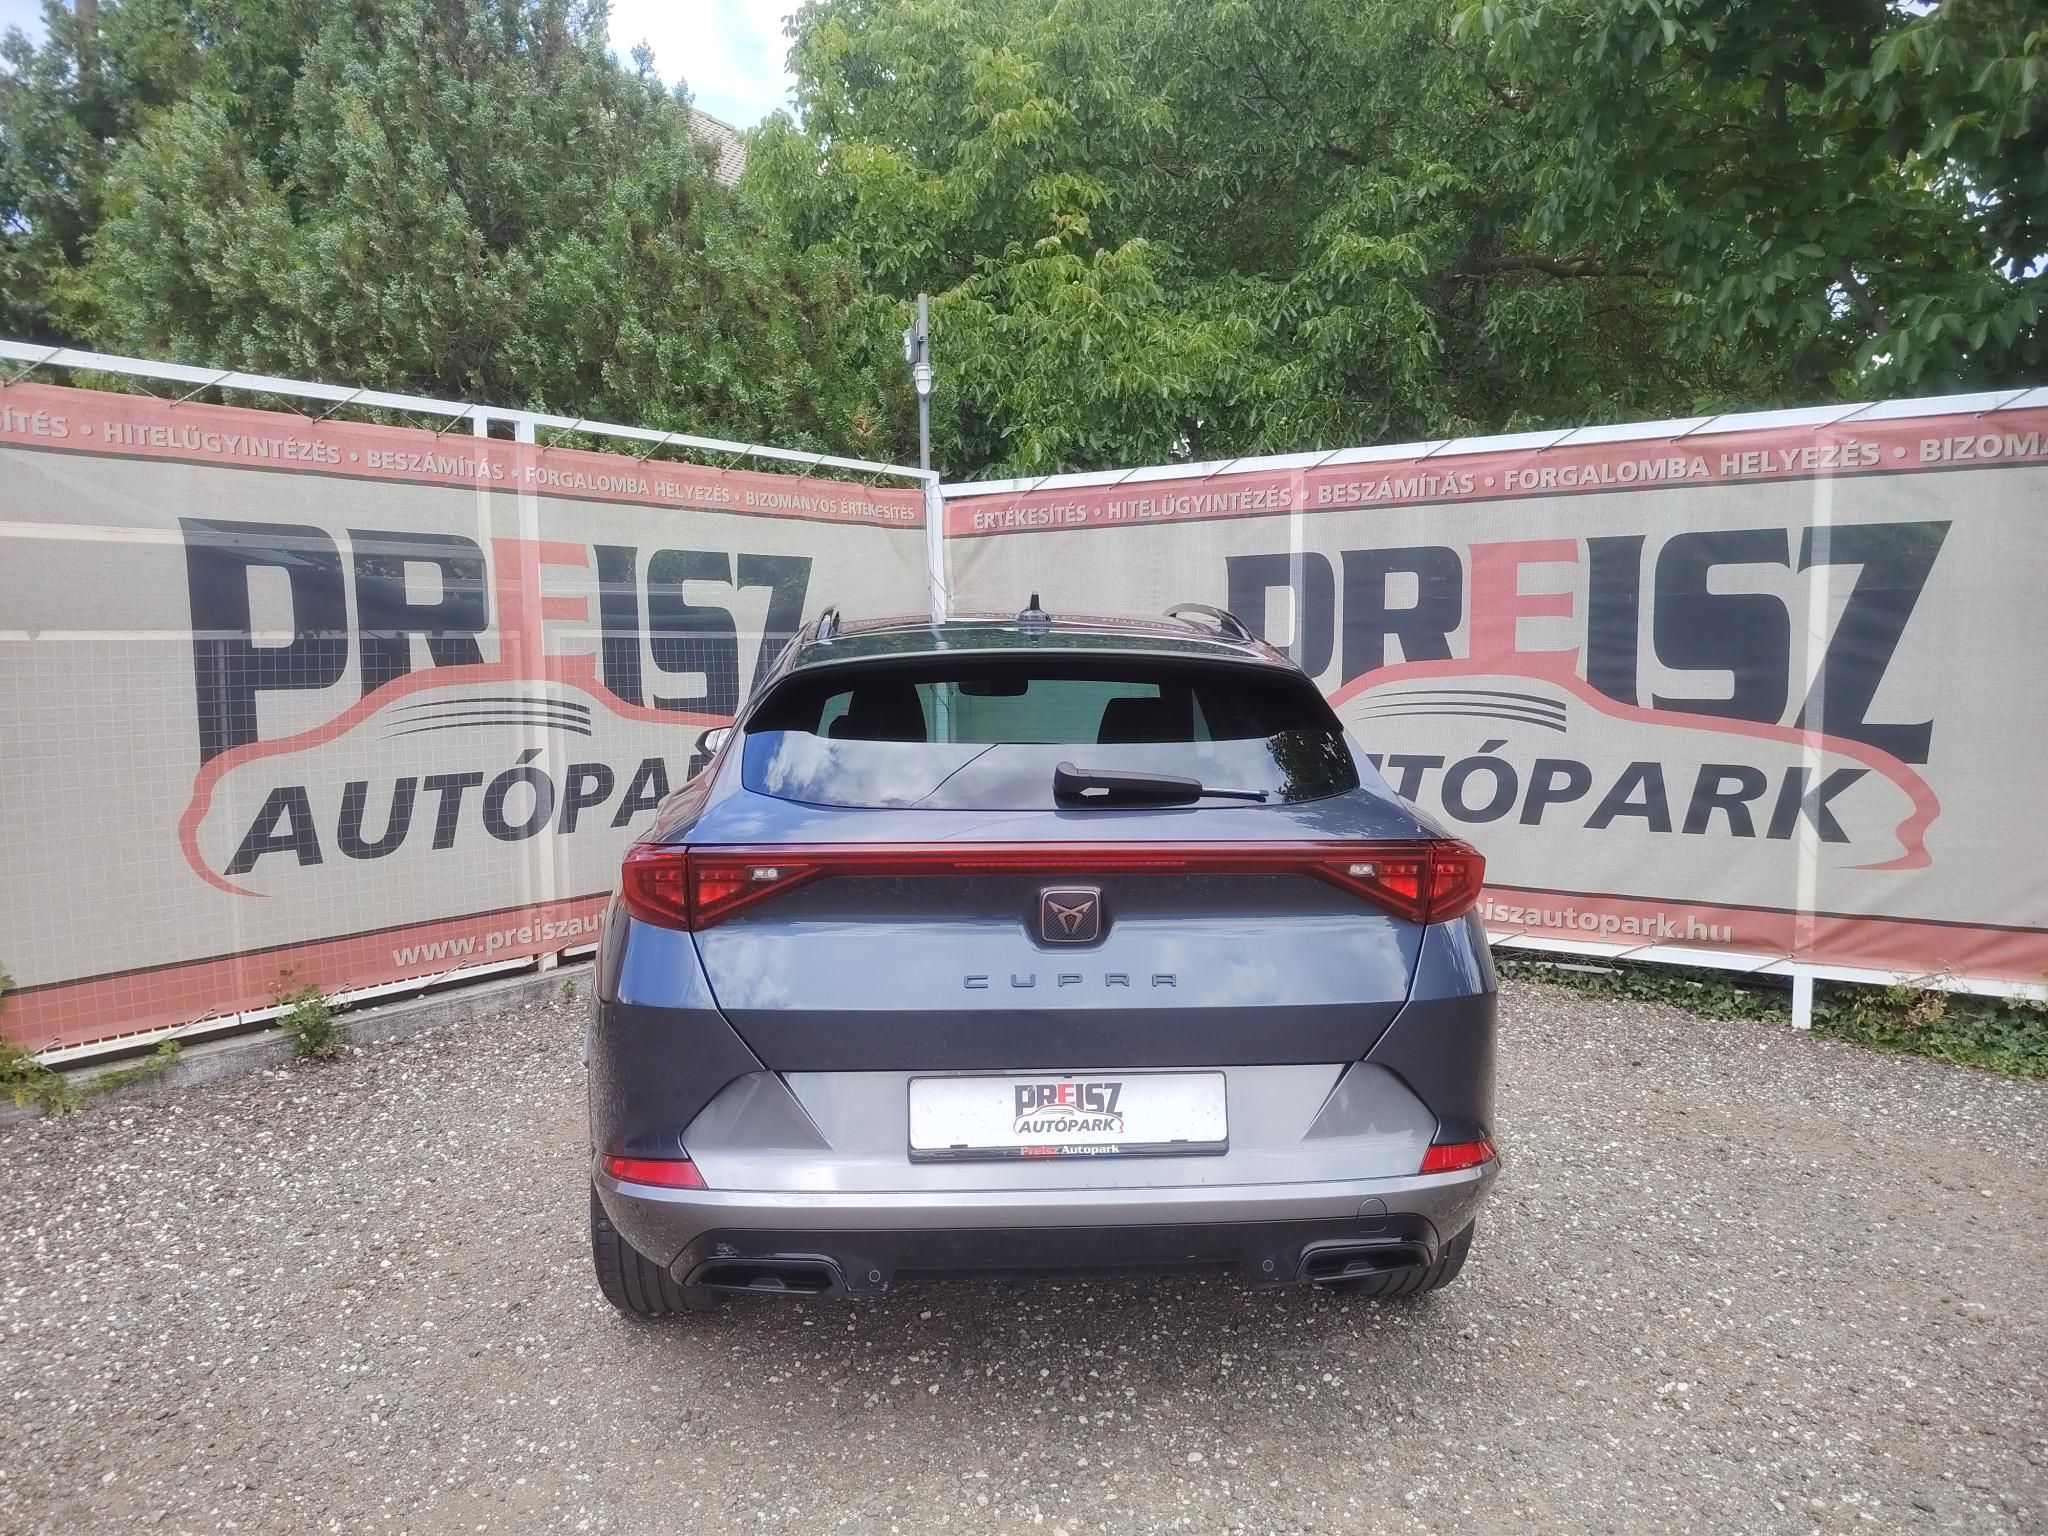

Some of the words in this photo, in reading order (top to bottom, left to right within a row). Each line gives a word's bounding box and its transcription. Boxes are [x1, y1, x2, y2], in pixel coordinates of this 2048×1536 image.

[0, 404, 70, 438] ÍTÉS
[103, 421, 341, 464] HITELÜGYINTÉZÉS
[367, 448, 504, 481] BESZÁMÍTÁS
[525, 466, 650, 496] FORGALOMBA
[655, 475, 730, 504] HELYEZÉS
[746, 490, 837, 514] BIZOMÁNYOS
[972, 502, 1088, 531] ÉRTÉKESÍTÉS
[1107, 486, 1293, 520] HITELÜGYINTÉZÉS
[1318, 471, 1476, 504] BESZÁMÍTÁS
[1504, 455, 1711, 491] FORGALOMBA
[1720, 440, 1881, 475] HELYEZÉS
[178, 517, 813, 763] PREISZ
[1225, 520, 1953, 764] PREISZ
[224, 748, 716, 876] AUTÓPA
[963, 973, 1177, 989] CUPRA
[1014, 1082, 1123, 1117] PREISZ
[1018, 1116, 1116, 1134] AUTÓPARK
[1020, 1147, 1059, 1156] Preisz
[1061, 1145, 1120, 1157] Autopark
